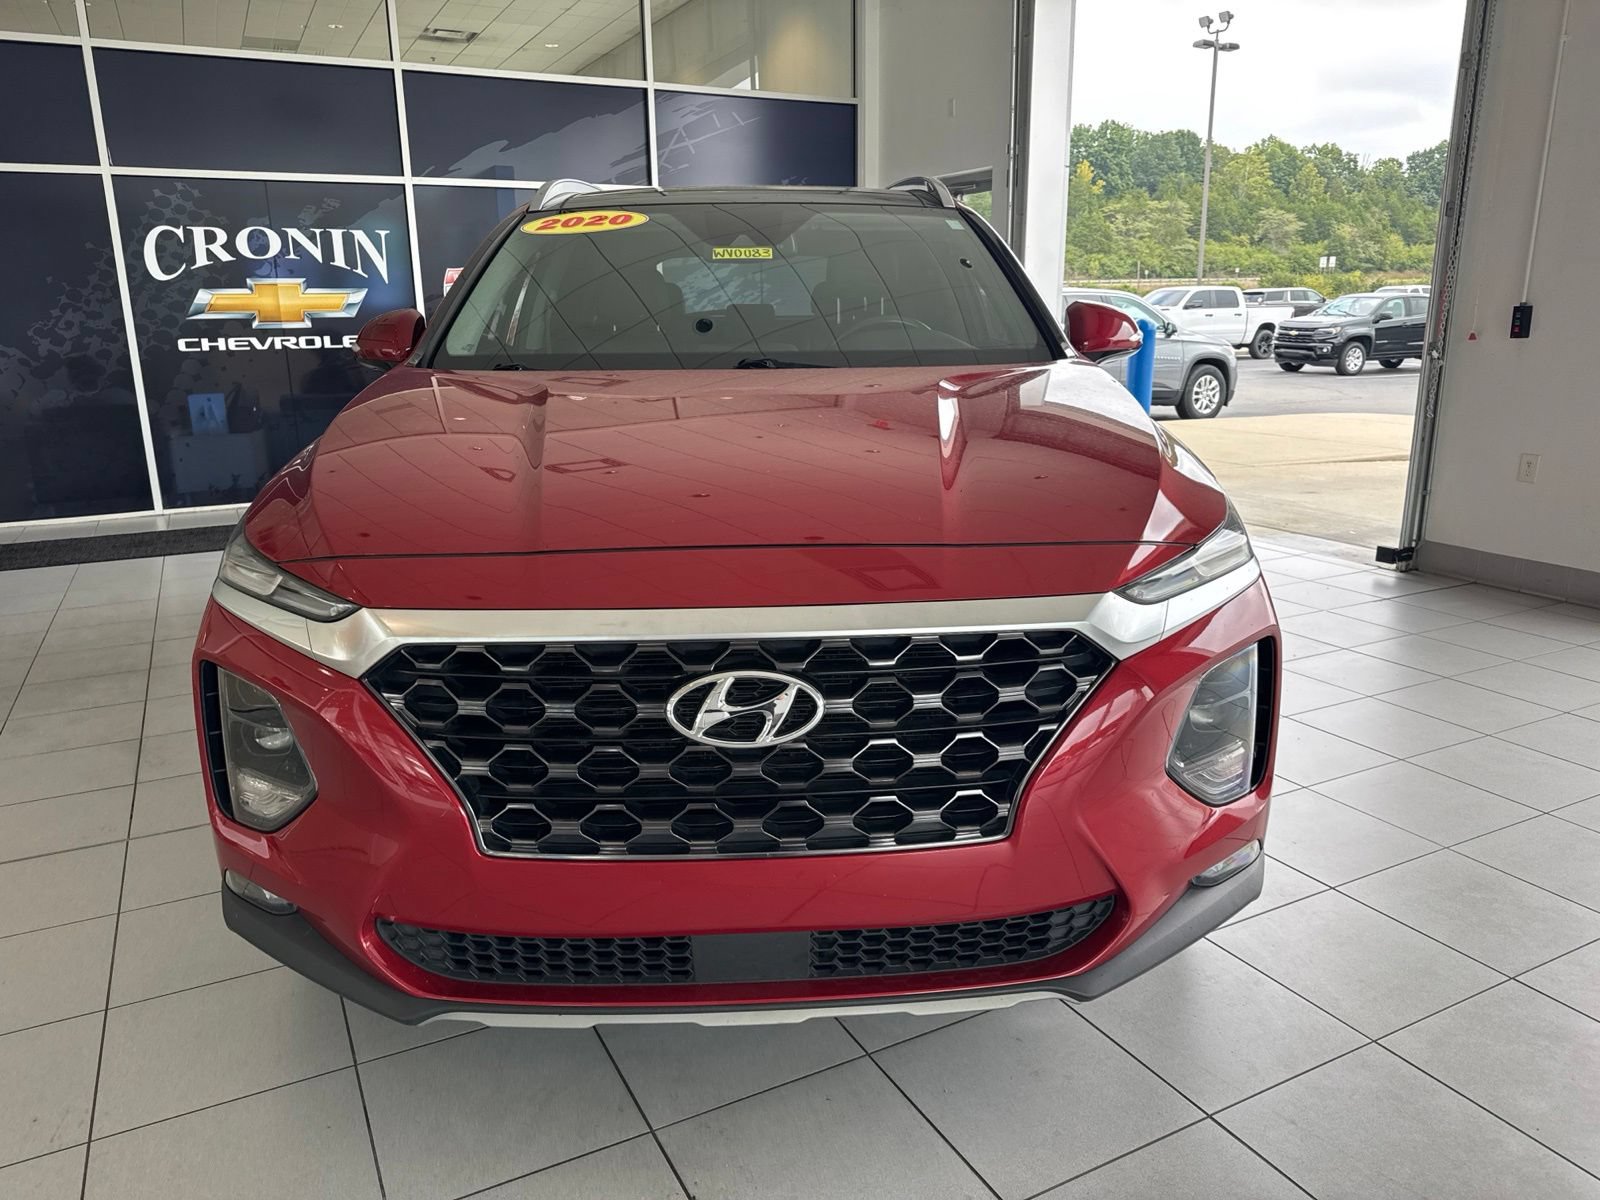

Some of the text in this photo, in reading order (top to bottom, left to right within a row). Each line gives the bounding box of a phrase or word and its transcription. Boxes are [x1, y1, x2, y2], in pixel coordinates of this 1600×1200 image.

[535, 214, 634, 231] 2020
[143, 225, 390, 284] CRONIN
[177, 334, 359, 352] CHEVROLE
